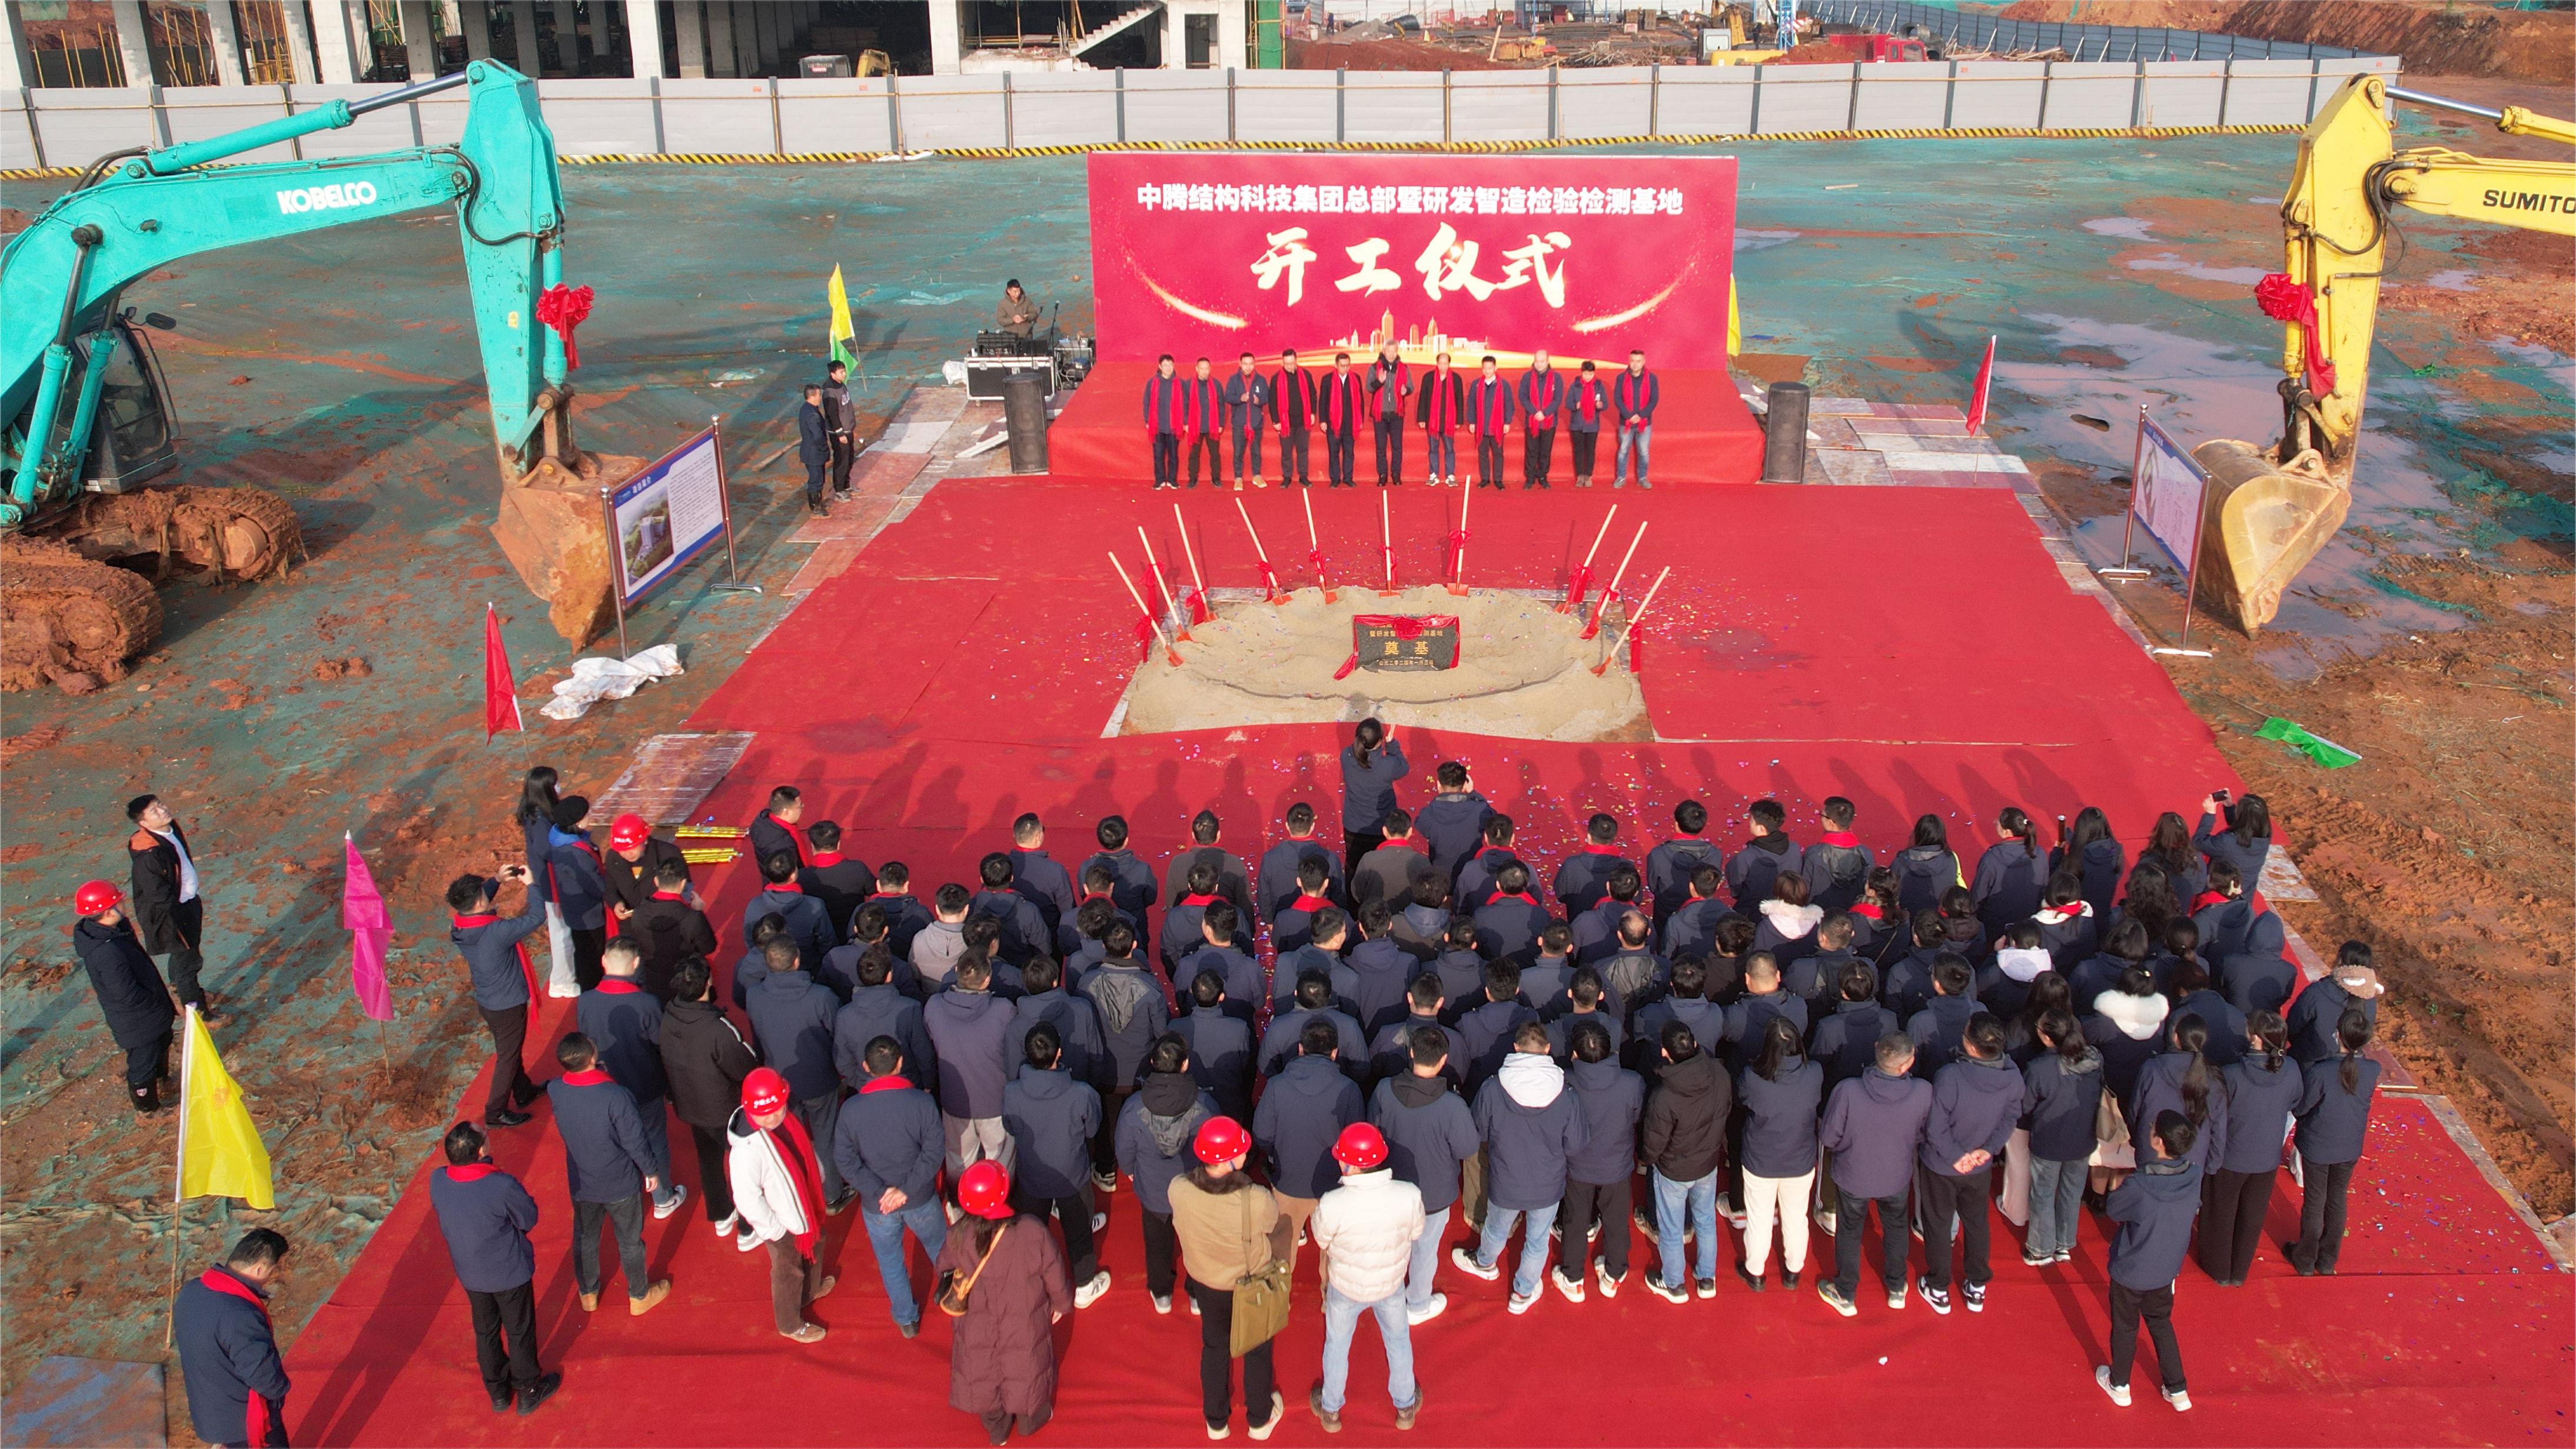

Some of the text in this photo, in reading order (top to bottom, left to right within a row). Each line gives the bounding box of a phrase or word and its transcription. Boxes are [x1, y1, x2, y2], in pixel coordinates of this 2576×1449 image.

[277, 181, 377, 214] KOBELCO
[1137, 182, 1683, 215] 中腾结构科技集团总部暨研发智造检验检测基地
[2483, 190, 2576, 214] SUMITO
[1250, 221, 1571, 308] 开工仪式
